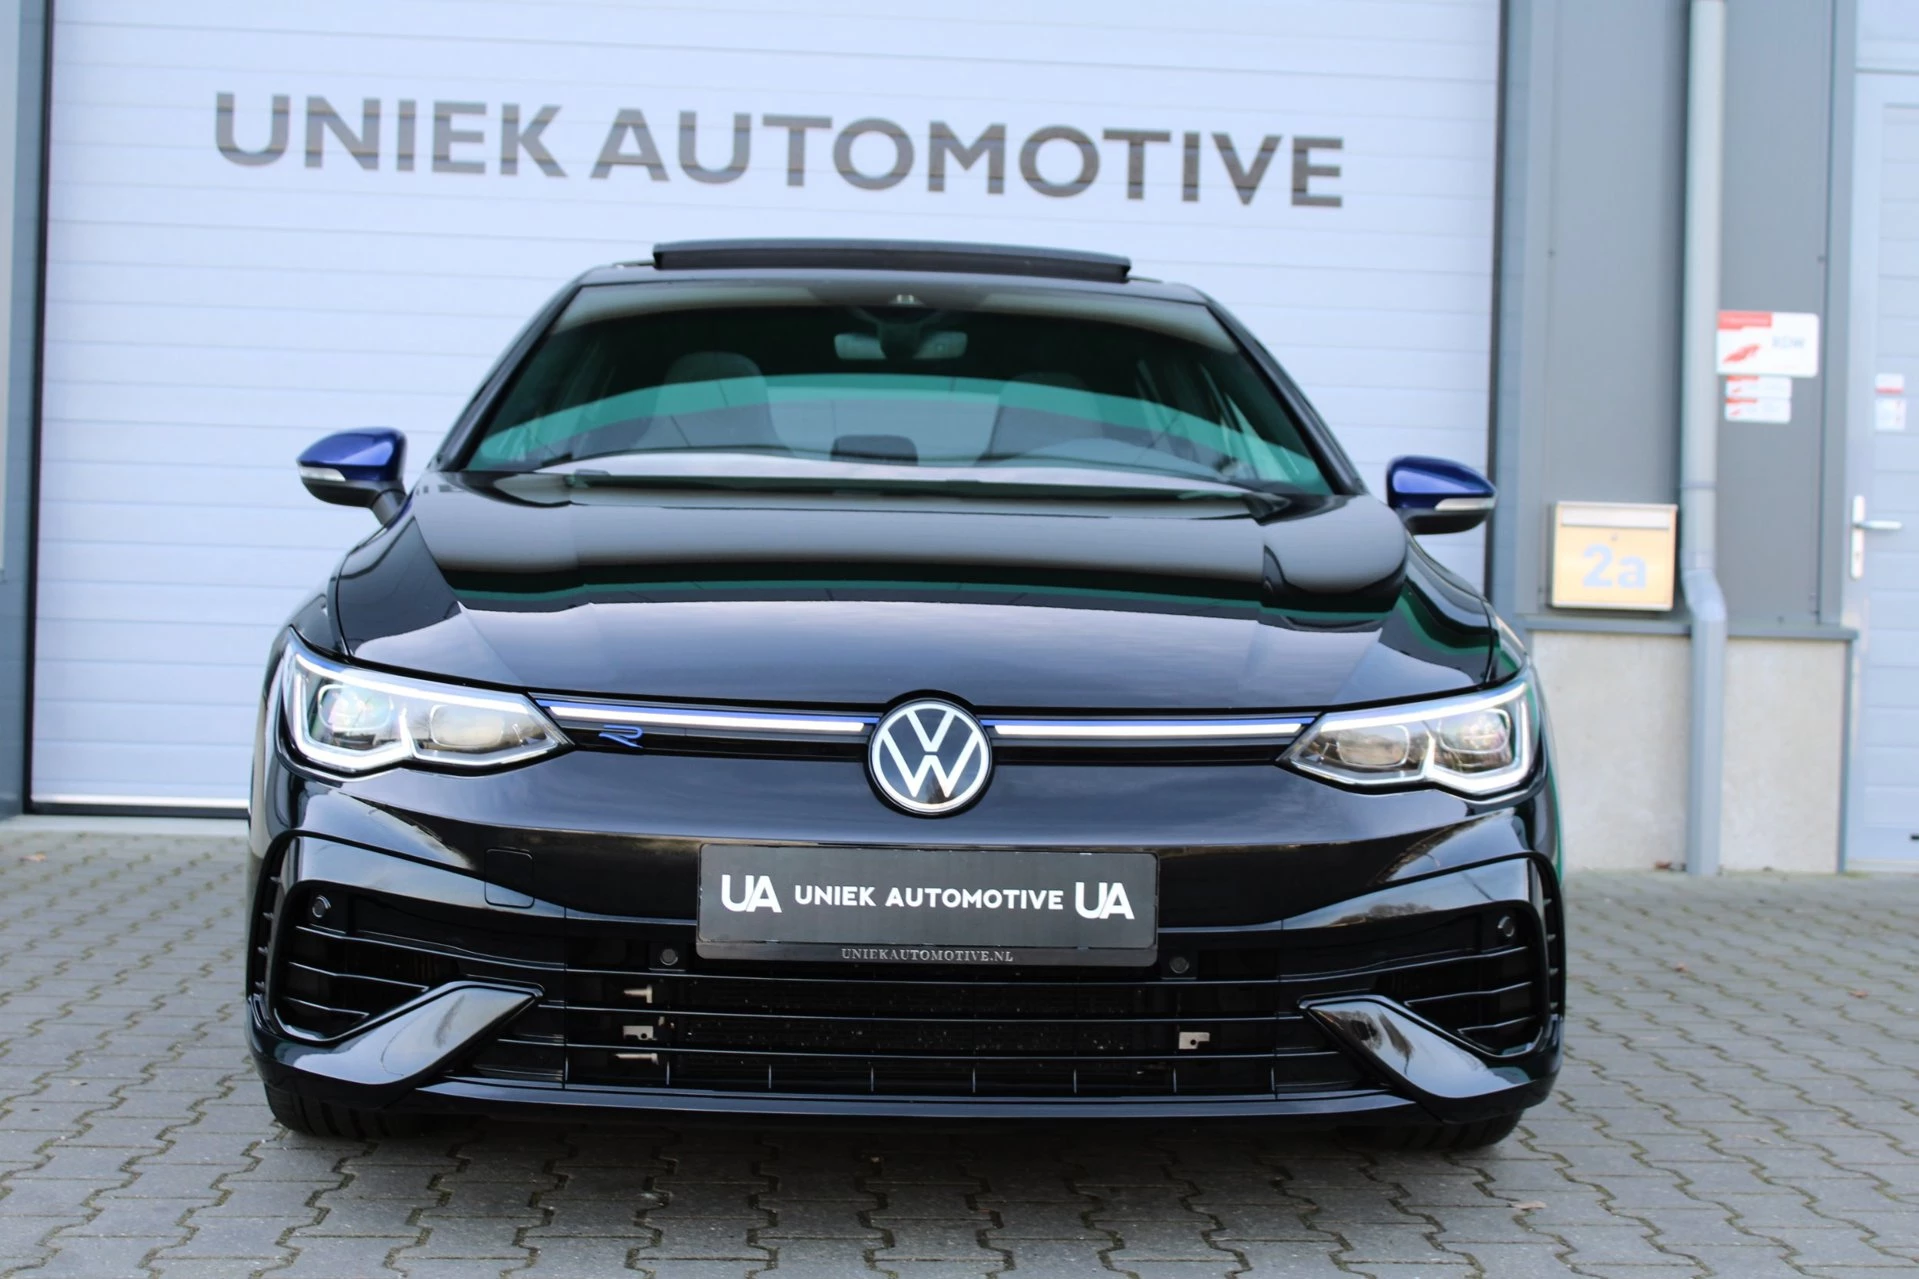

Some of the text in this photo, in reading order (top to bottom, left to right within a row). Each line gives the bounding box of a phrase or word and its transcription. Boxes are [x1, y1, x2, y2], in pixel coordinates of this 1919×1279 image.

[215, 92, 1344, 208] UNIEK AUTOMOTIVE
[1582, 543, 1647, 588] 2a
[721, 873, 1135, 920] UA UNIEK AUTOMOTIVE UA
[841, 948, 1014, 962] UNIEKAUTOMOTIVE.NL
